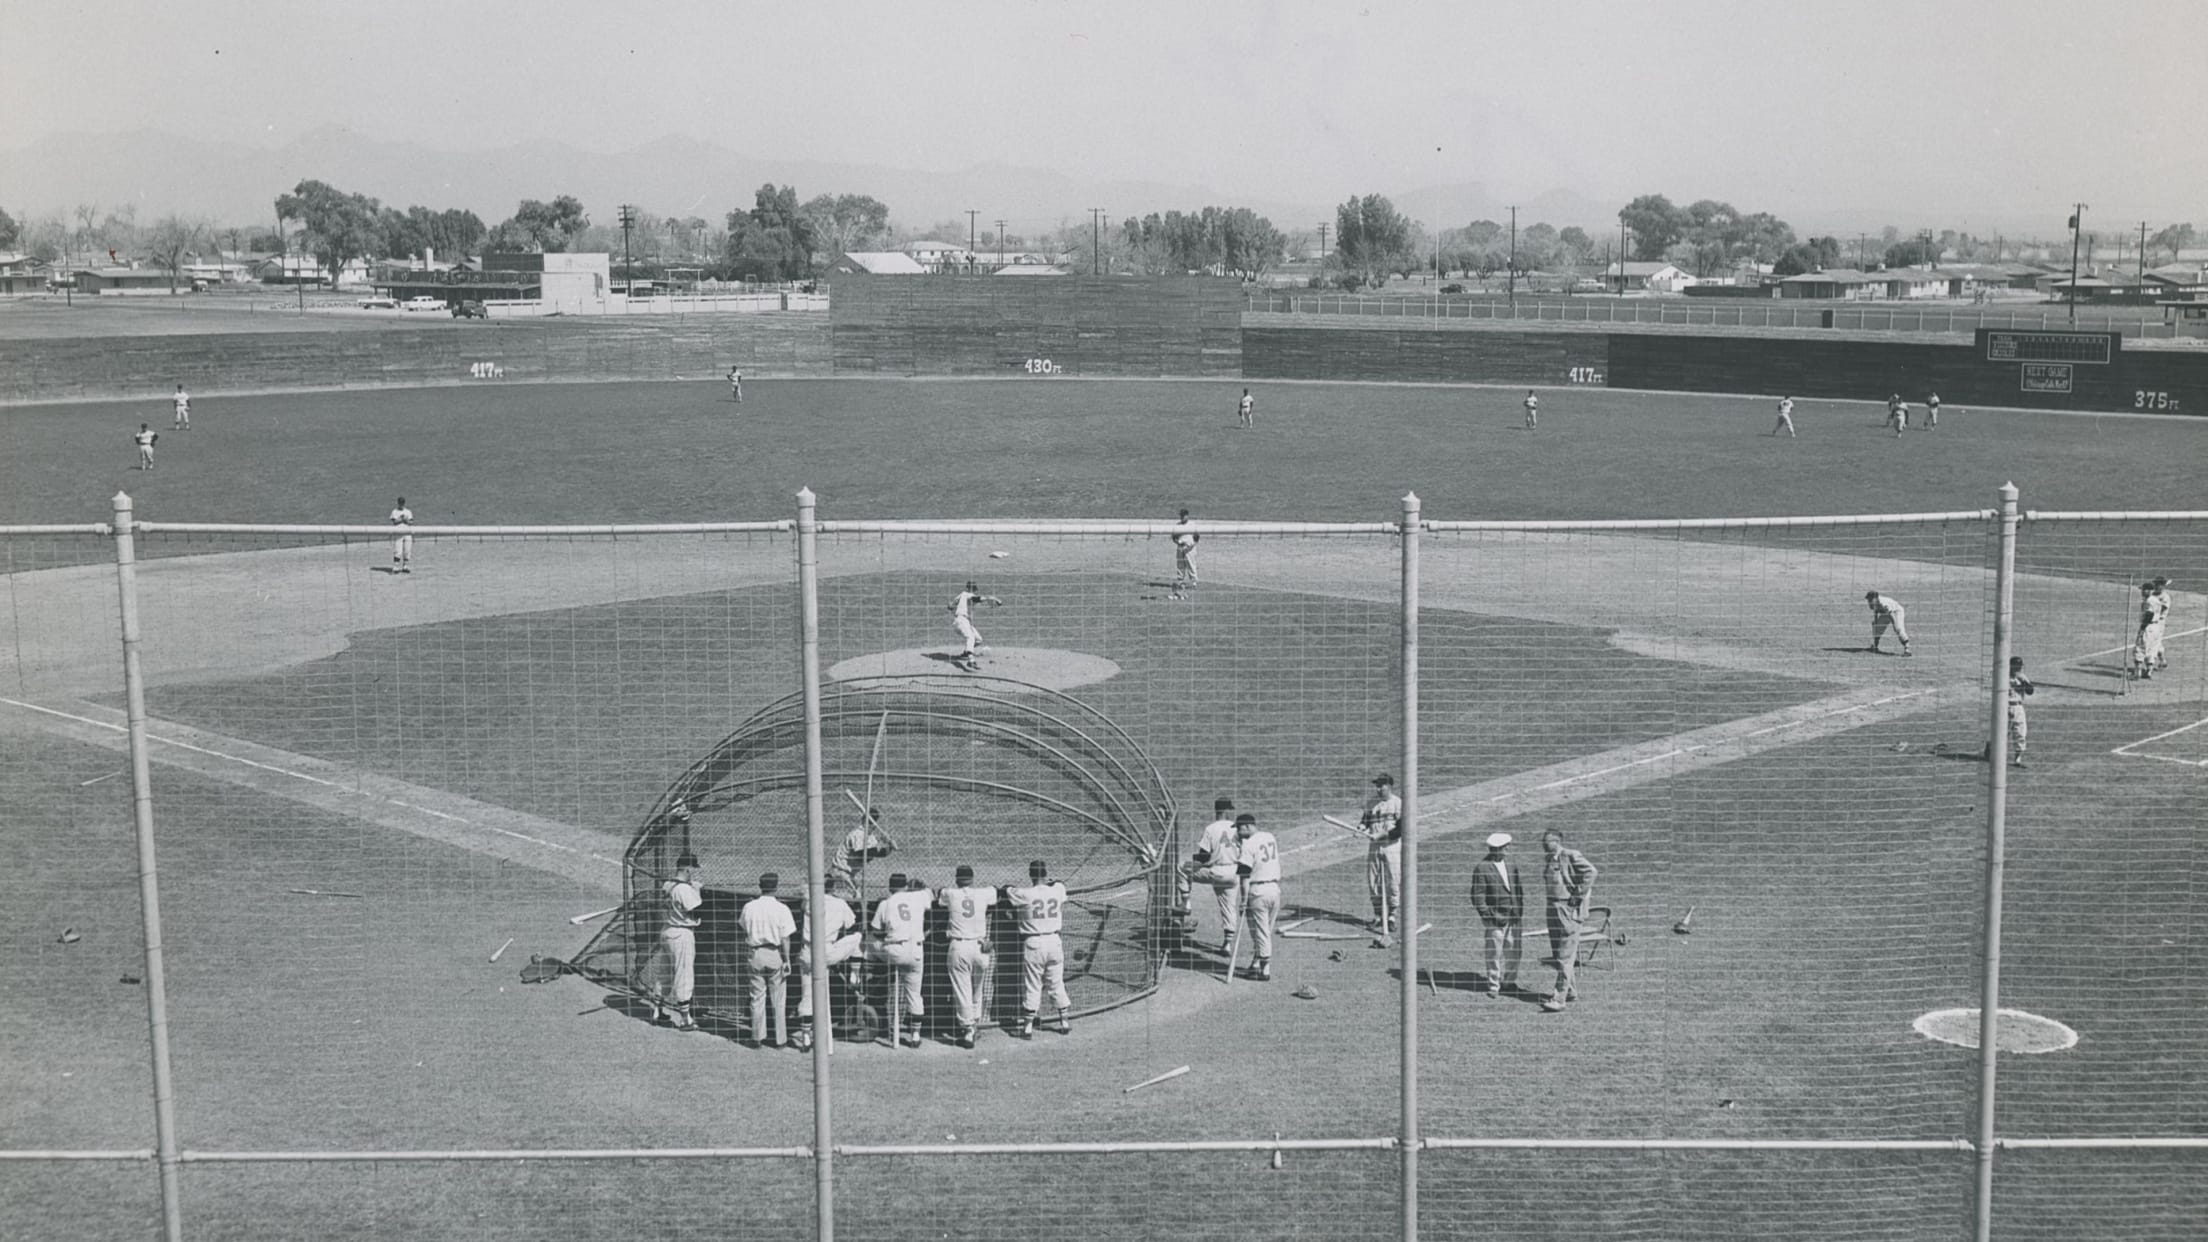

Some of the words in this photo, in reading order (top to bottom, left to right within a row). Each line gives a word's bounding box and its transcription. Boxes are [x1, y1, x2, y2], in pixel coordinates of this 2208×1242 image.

[1259, 841, 1277, 863] 37
[897, 903, 912, 921] 6
[962, 899, 975, 918] 9
[1032, 898, 1058, 919] 22
